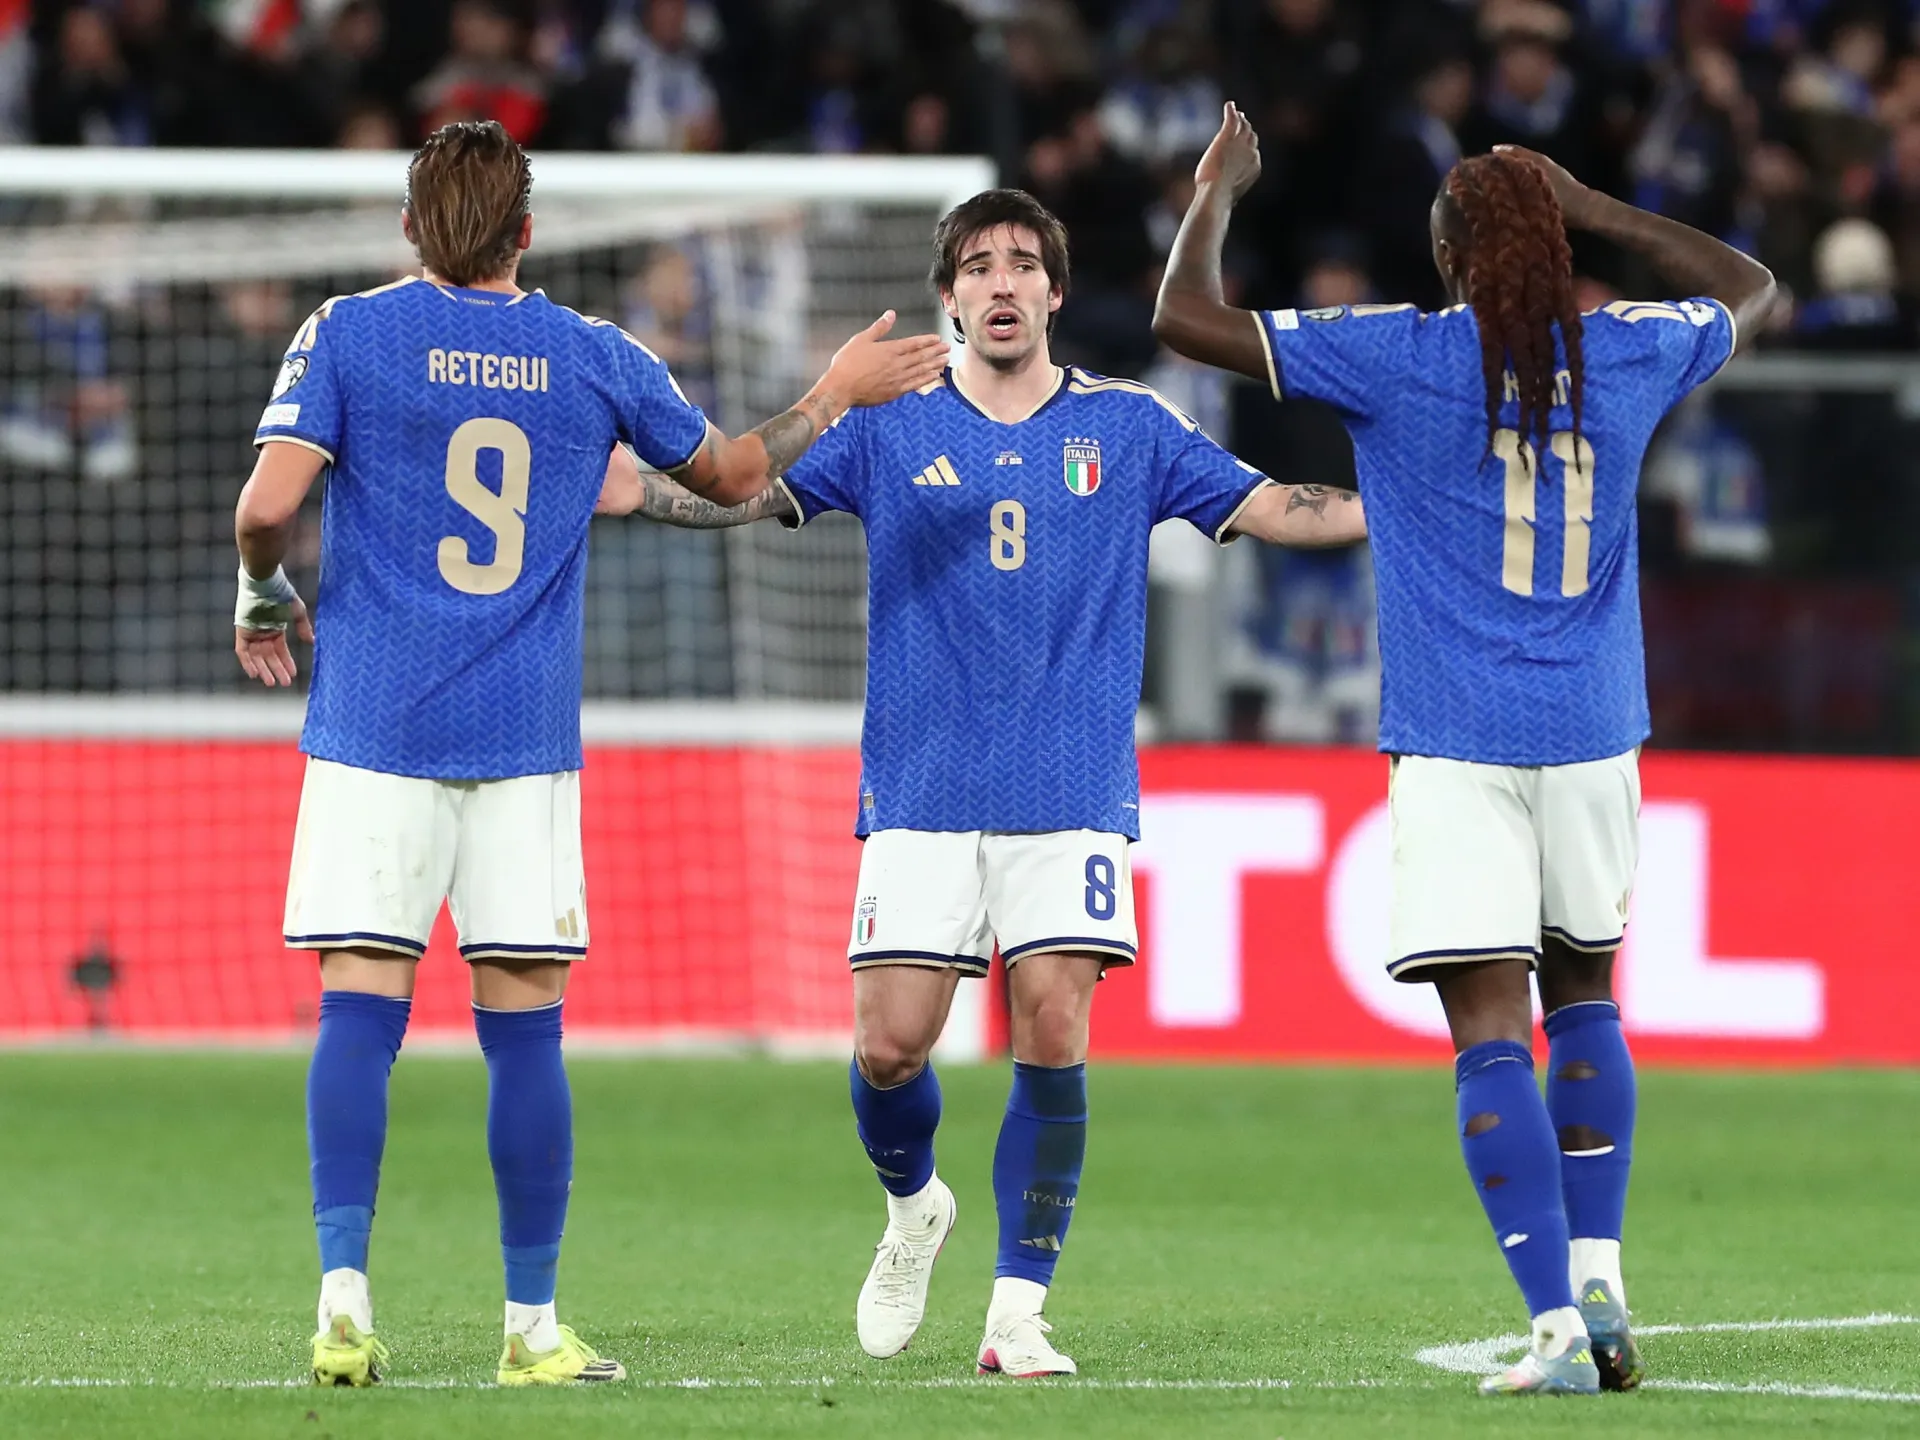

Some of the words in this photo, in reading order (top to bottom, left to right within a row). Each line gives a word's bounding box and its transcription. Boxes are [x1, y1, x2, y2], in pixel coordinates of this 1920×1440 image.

[428, 348, 548, 393] RETEGUI
[1502, 368, 1574, 406] KN
[1067, 449, 1097, 460] ITALIA
[437, 417, 531, 595] 9
[1493, 427, 1595, 597] 11
[990, 499, 1026, 572] 8
[1085, 854, 1116, 921] 8
[1023, 1190, 1076, 1208] ITALIA
